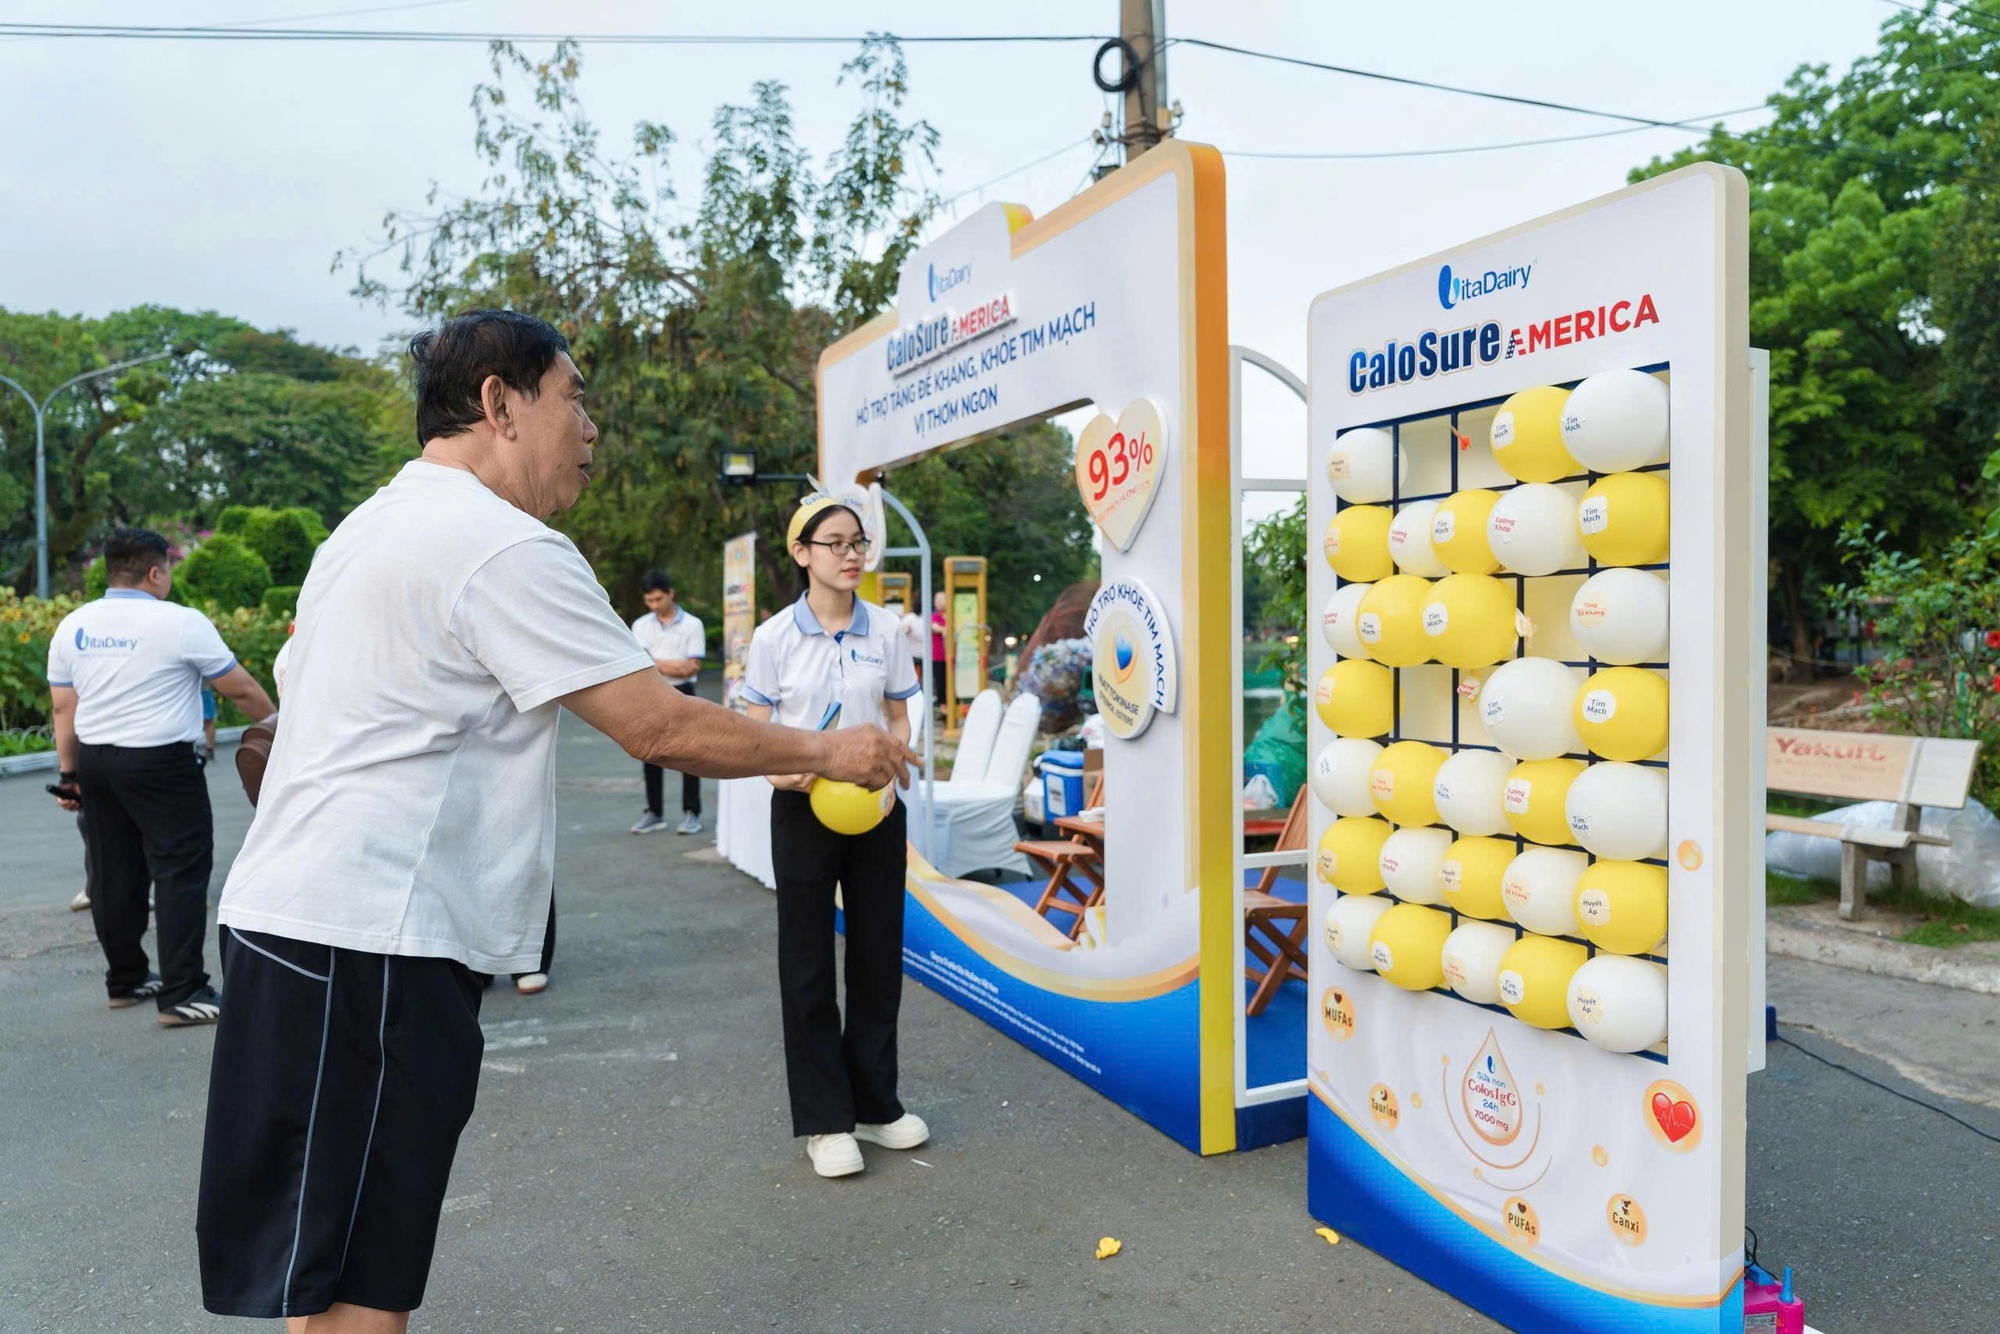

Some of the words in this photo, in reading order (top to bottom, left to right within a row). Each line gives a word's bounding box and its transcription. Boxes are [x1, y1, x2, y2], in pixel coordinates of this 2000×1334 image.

[887, 316, 949, 371] CaloSure
[951, 295, 1010, 343] AMERICA
[1020, 325, 1044, 356] TIM
[1049, 301, 1095, 346] MẠCH
[1349, 321, 1500, 393] CaloSure
[1505, 294, 1660, 359] AMERICA
[961, 384, 998, 417] NGON
[1089, 431, 1153, 501] 93%
[1145, 605, 1159, 641] TIM
[1154, 643, 1166, 707] MẠCH
[1325, 1006, 1352, 1027] MUFAs
[1467, 1079, 1516, 1106] ColosIgG
[1492, 1078, 1506, 1088] non
[1371, 1097, 1398, 1119] Taurine
[1483, 1098, 1499, 1112] 24h
[1474, 1109, 1496, 1125] 7000
[1496, 1119, 1509, 1132] mg
[1508, 1212, 1536, 1236] PUFAs
[1612, 1212, 1639, 1234] Canxi
